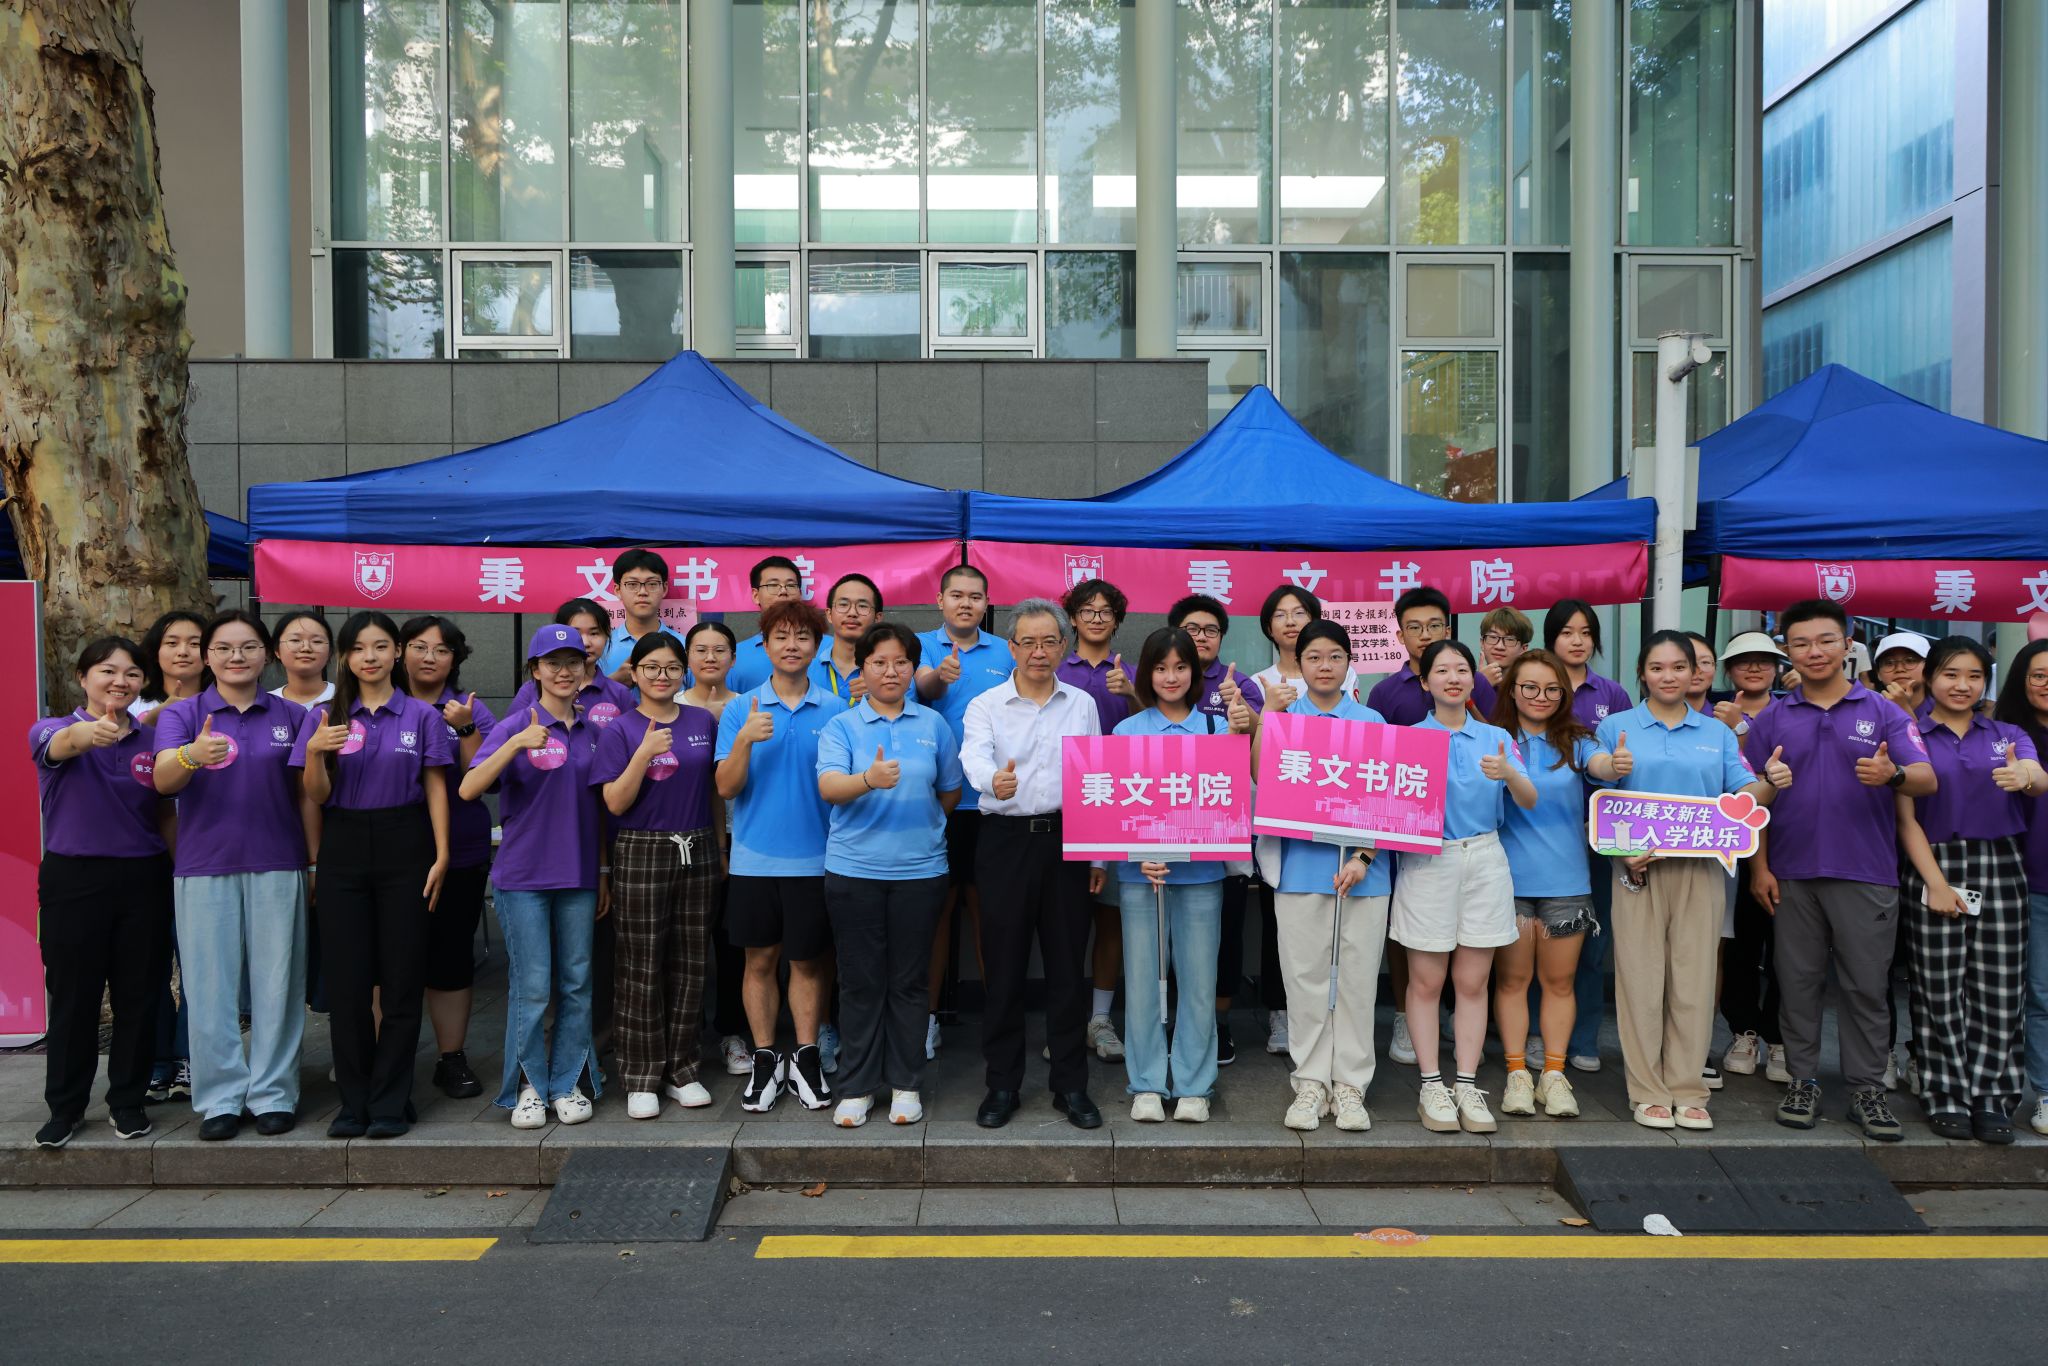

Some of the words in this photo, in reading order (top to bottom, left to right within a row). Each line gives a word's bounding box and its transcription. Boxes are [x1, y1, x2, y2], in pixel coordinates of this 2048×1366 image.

[1363, 652, 1402, 661] 111-180
[1277, 749, 1429, 799] 秉文书院
[1081, 771, 1233, 807] 秉文书院
[1603, 799, 1713, 824] 2024秉文新生
[1639, 825, 1741, 849] 入学快乐
